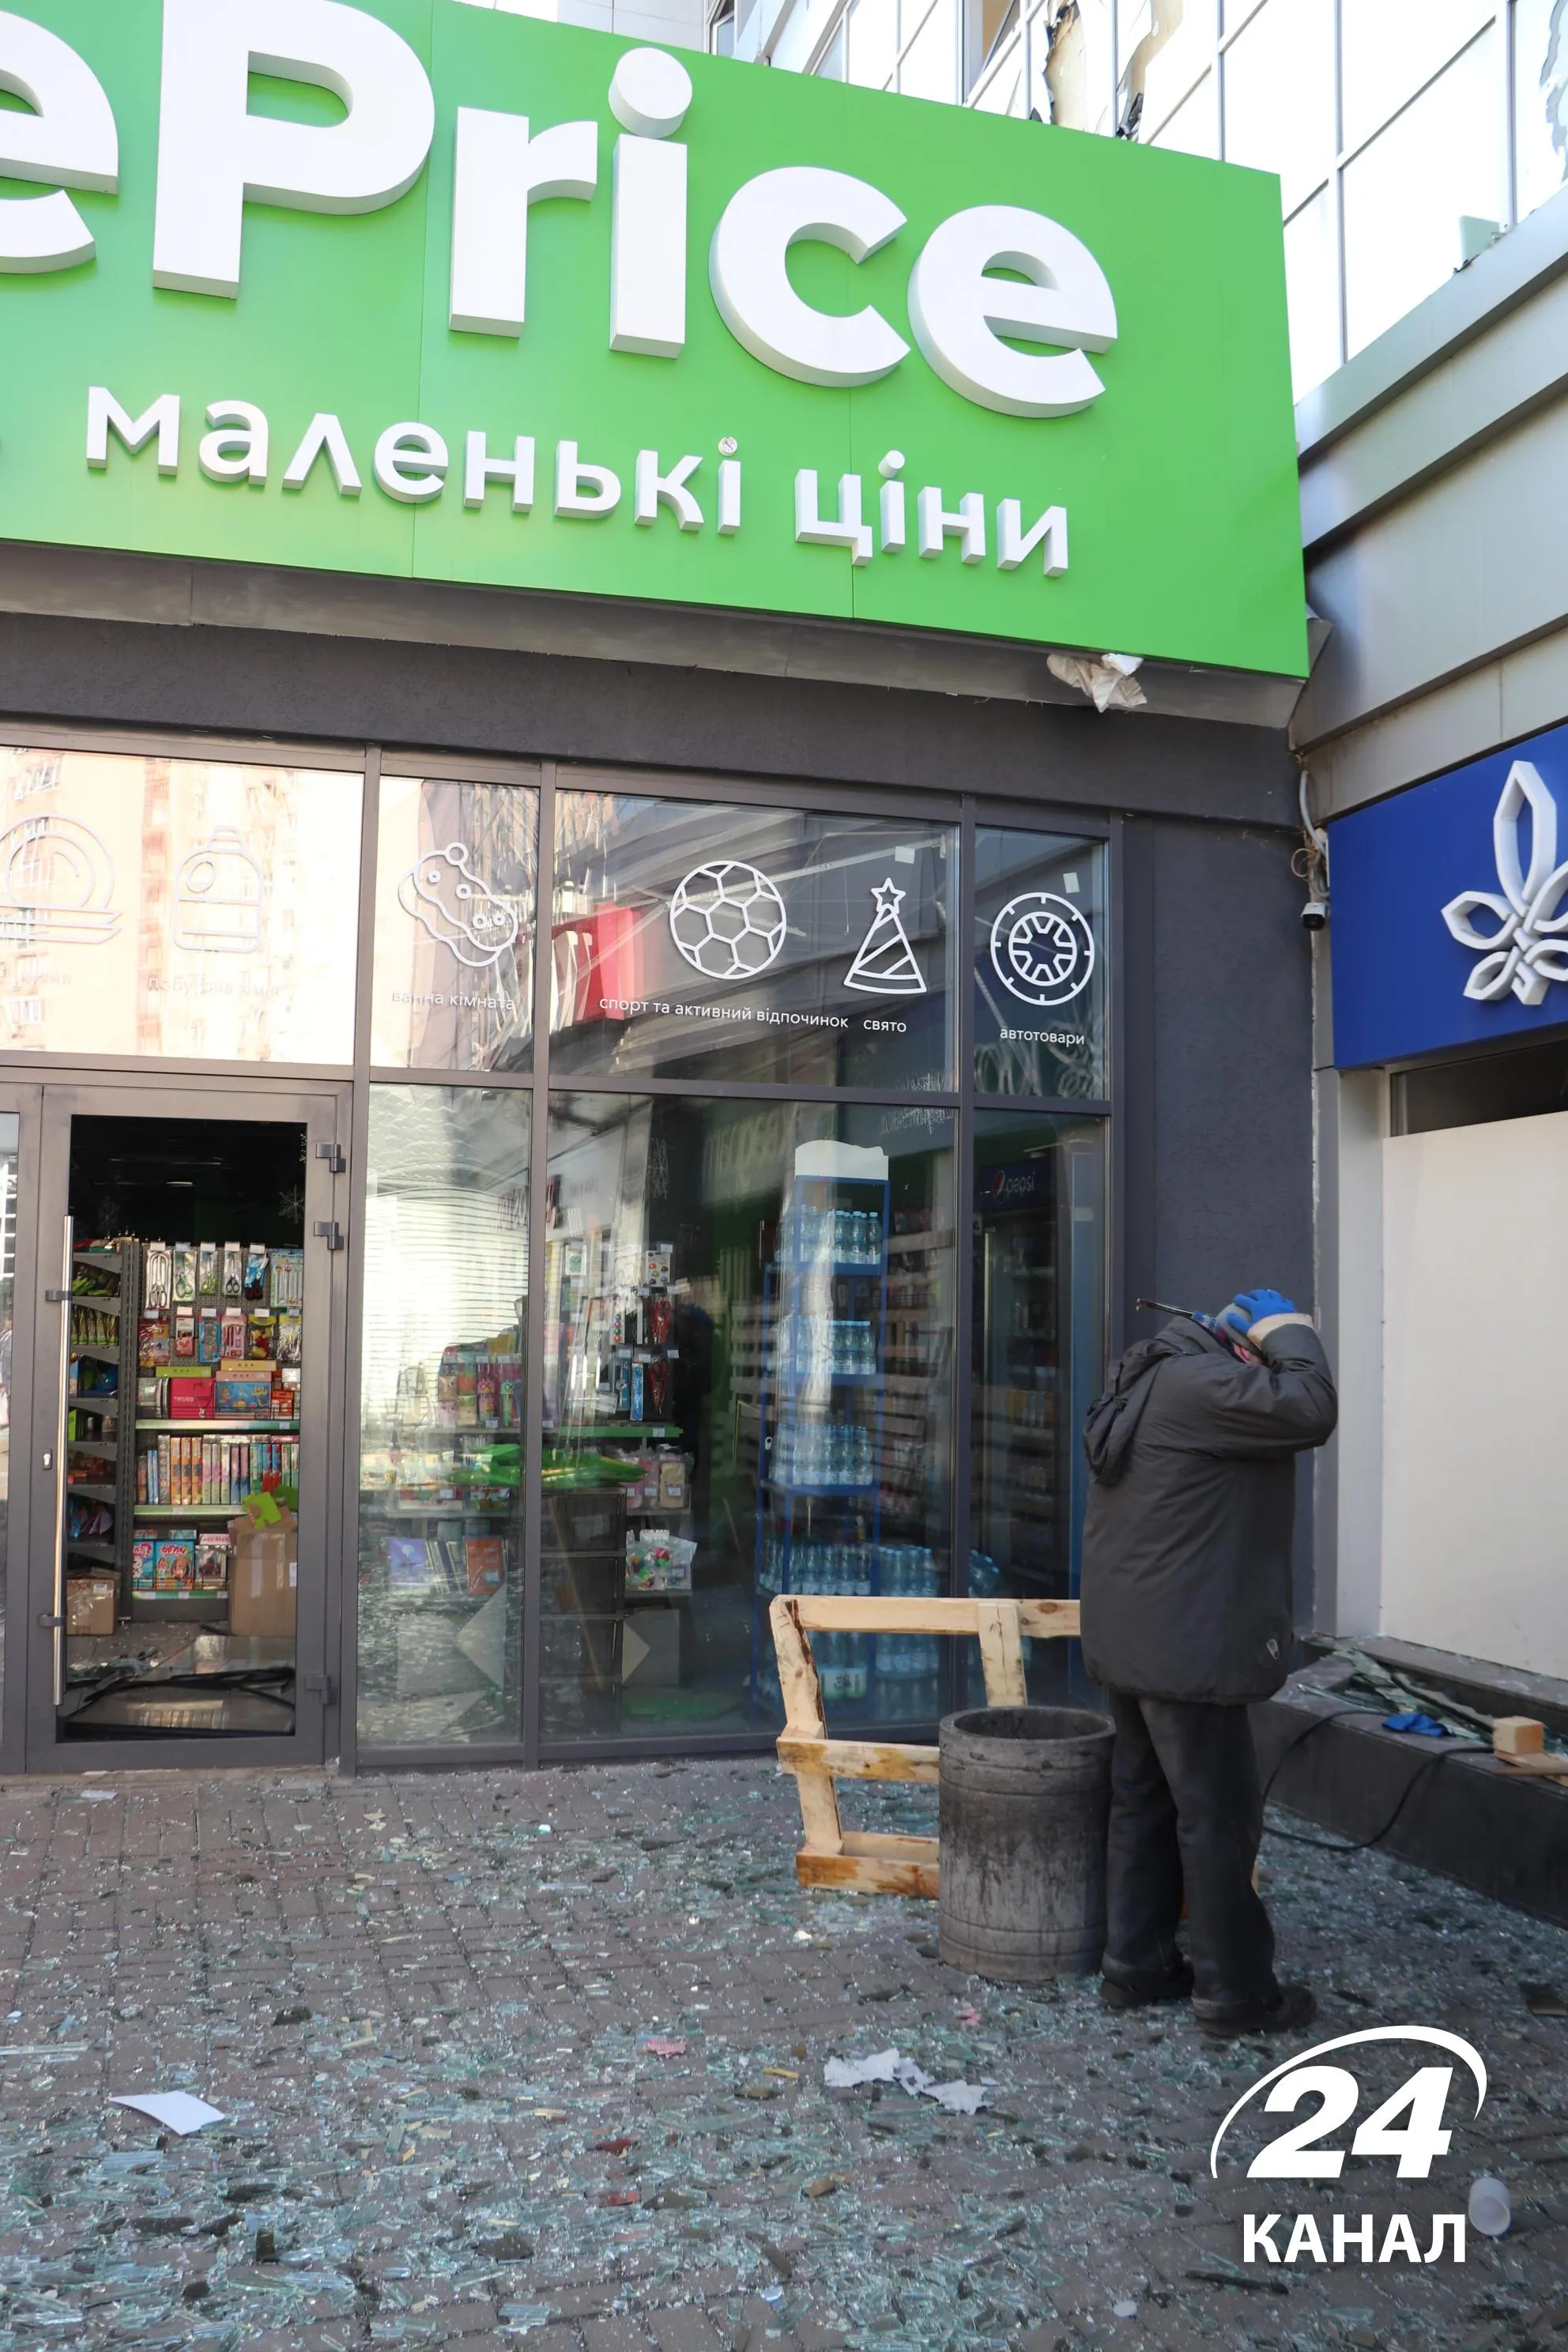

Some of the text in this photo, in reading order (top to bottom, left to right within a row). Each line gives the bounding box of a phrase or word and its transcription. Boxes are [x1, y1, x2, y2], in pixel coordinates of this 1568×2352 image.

[86, 386, 1069, 578] маленькі ціни
[392, 991, 516, 1010] ванна кімната
[599, 997, 849, 1027] спорт та активний відпочинок
[863, 1020, 906, 1033] свято
[1000, 1028, 1085, 1048] автотовари
[1005, 1170, 1036, 1200] pepsi
